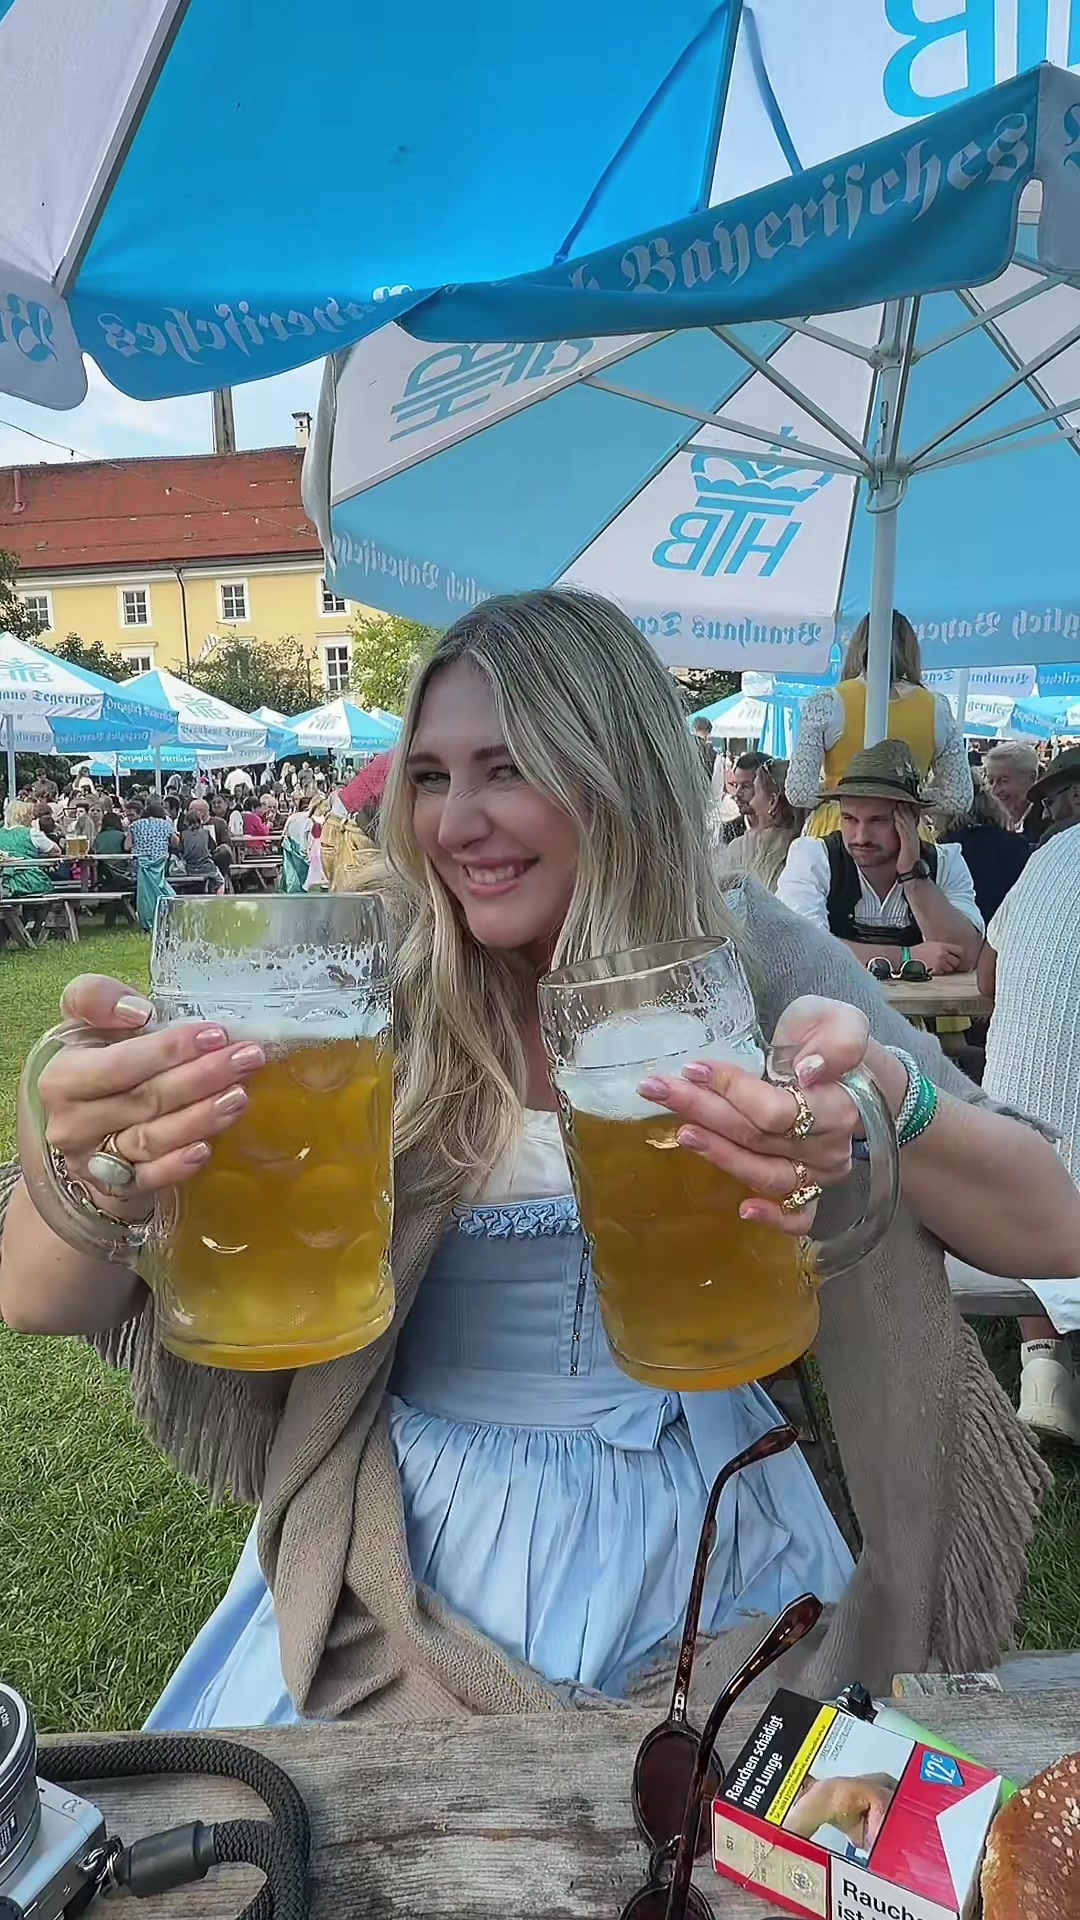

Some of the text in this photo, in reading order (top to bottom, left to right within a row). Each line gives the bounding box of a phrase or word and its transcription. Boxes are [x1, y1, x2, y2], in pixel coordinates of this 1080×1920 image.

[31, 689, 98, 707] Tegernsee
[725, 1755, 760, 1801] Rauchen
[753, 1715, 783, 1758] schädigt
[743, 1781, 766, 1810] Ihre
[755, 1752, 783, 1789] Lunge
[843, 1878, 924, 1920] Rauch
